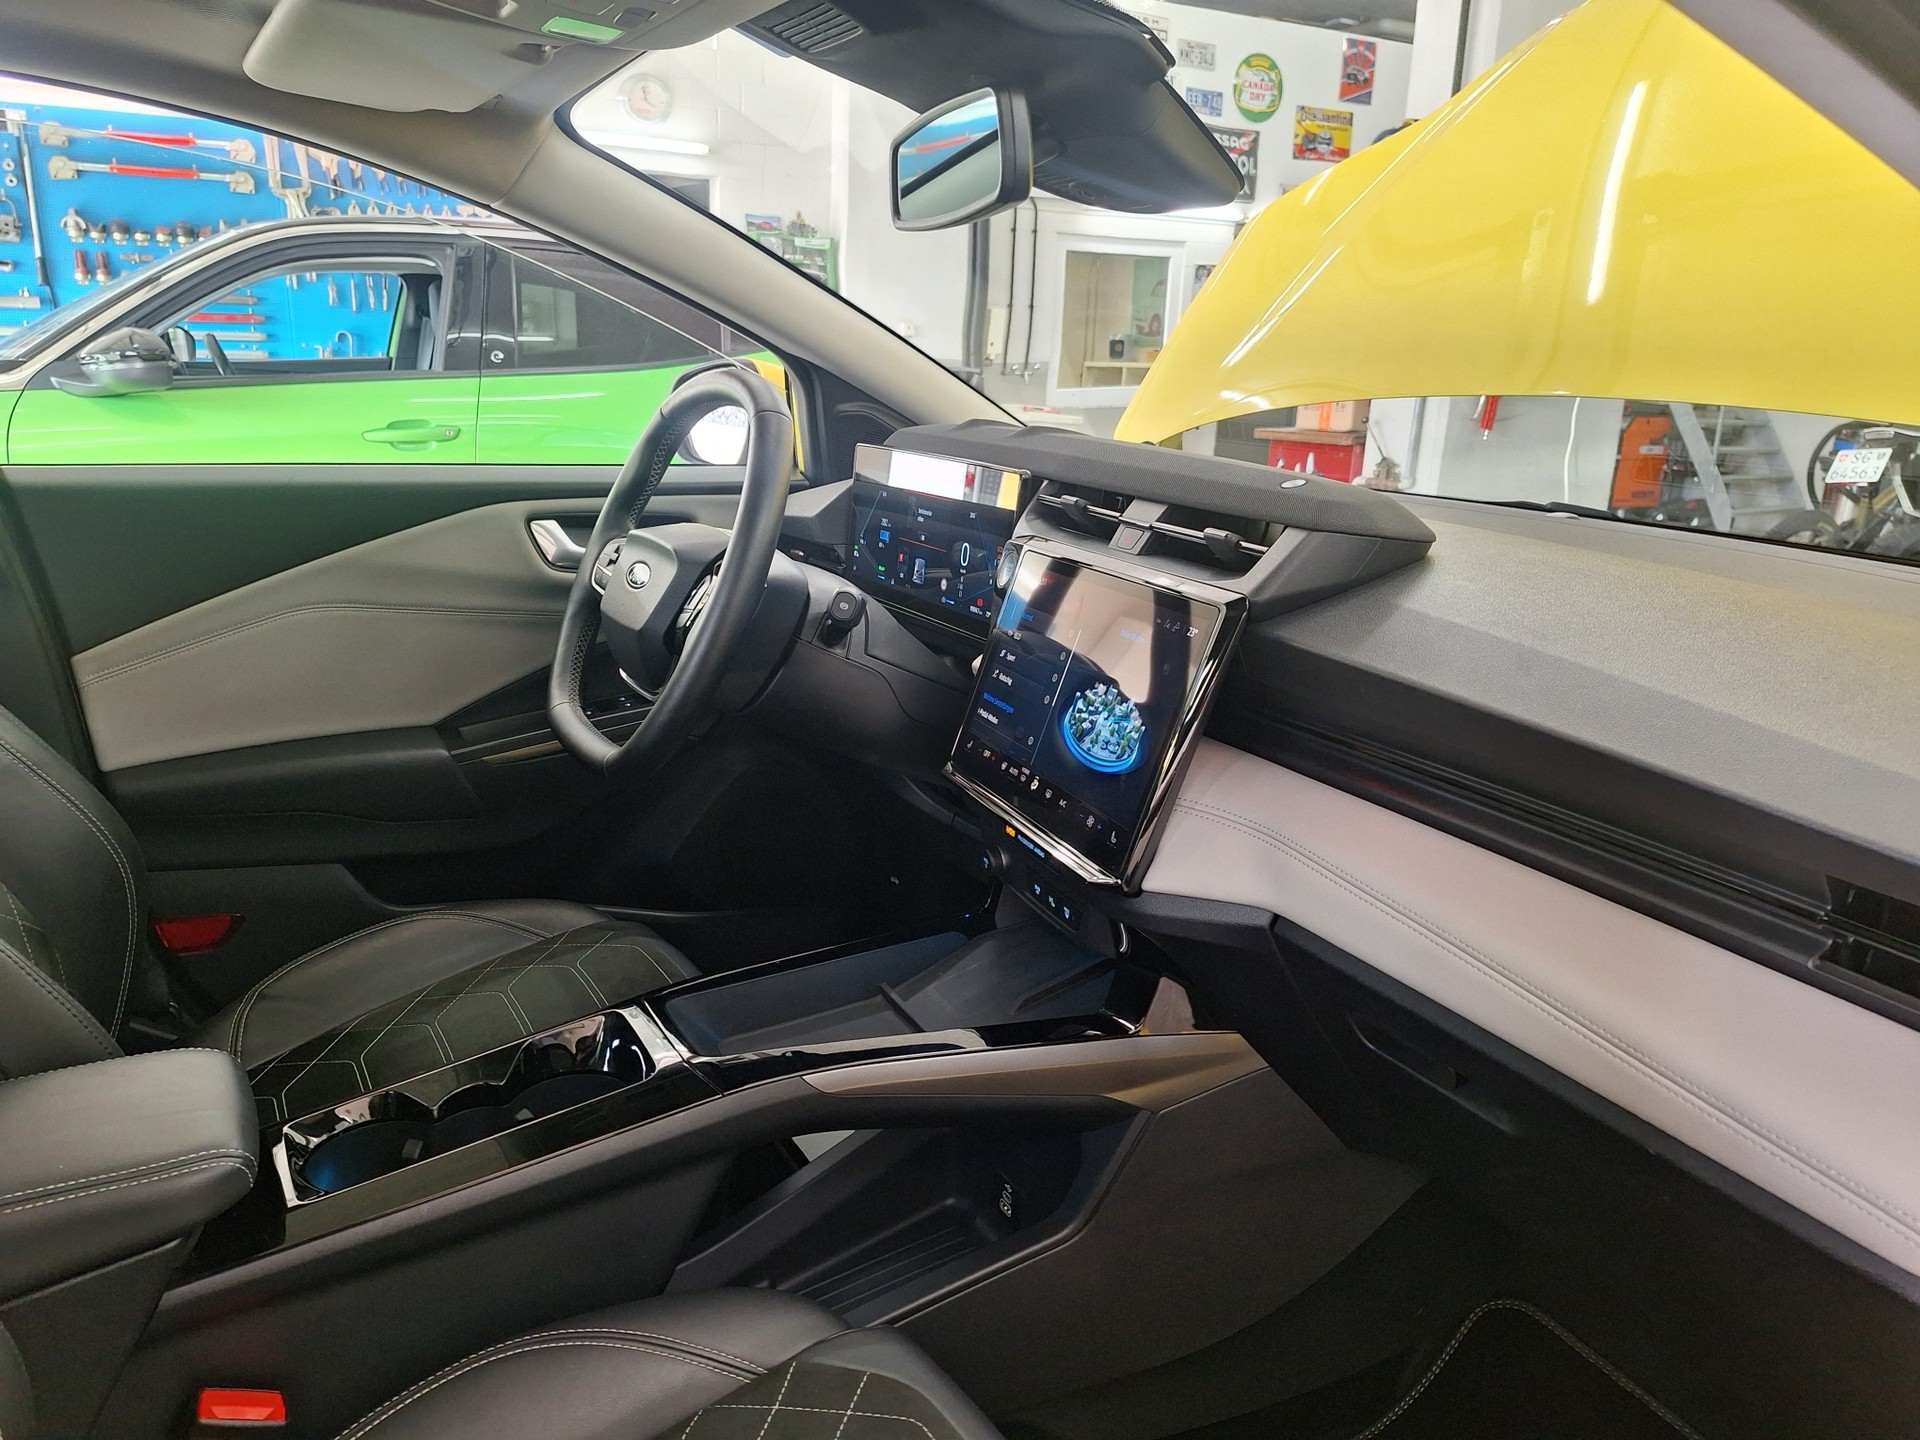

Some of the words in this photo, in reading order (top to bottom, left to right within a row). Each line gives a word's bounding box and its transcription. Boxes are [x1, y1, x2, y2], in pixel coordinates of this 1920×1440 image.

[1241, 80, 1275, 92] CANADA
[1249, 92, 1266, 101] DRY
[1851, 451, 1873, 464] SG
[1830, 466, 1880, 480] 64563
[960, 543, 970, 566] 0
